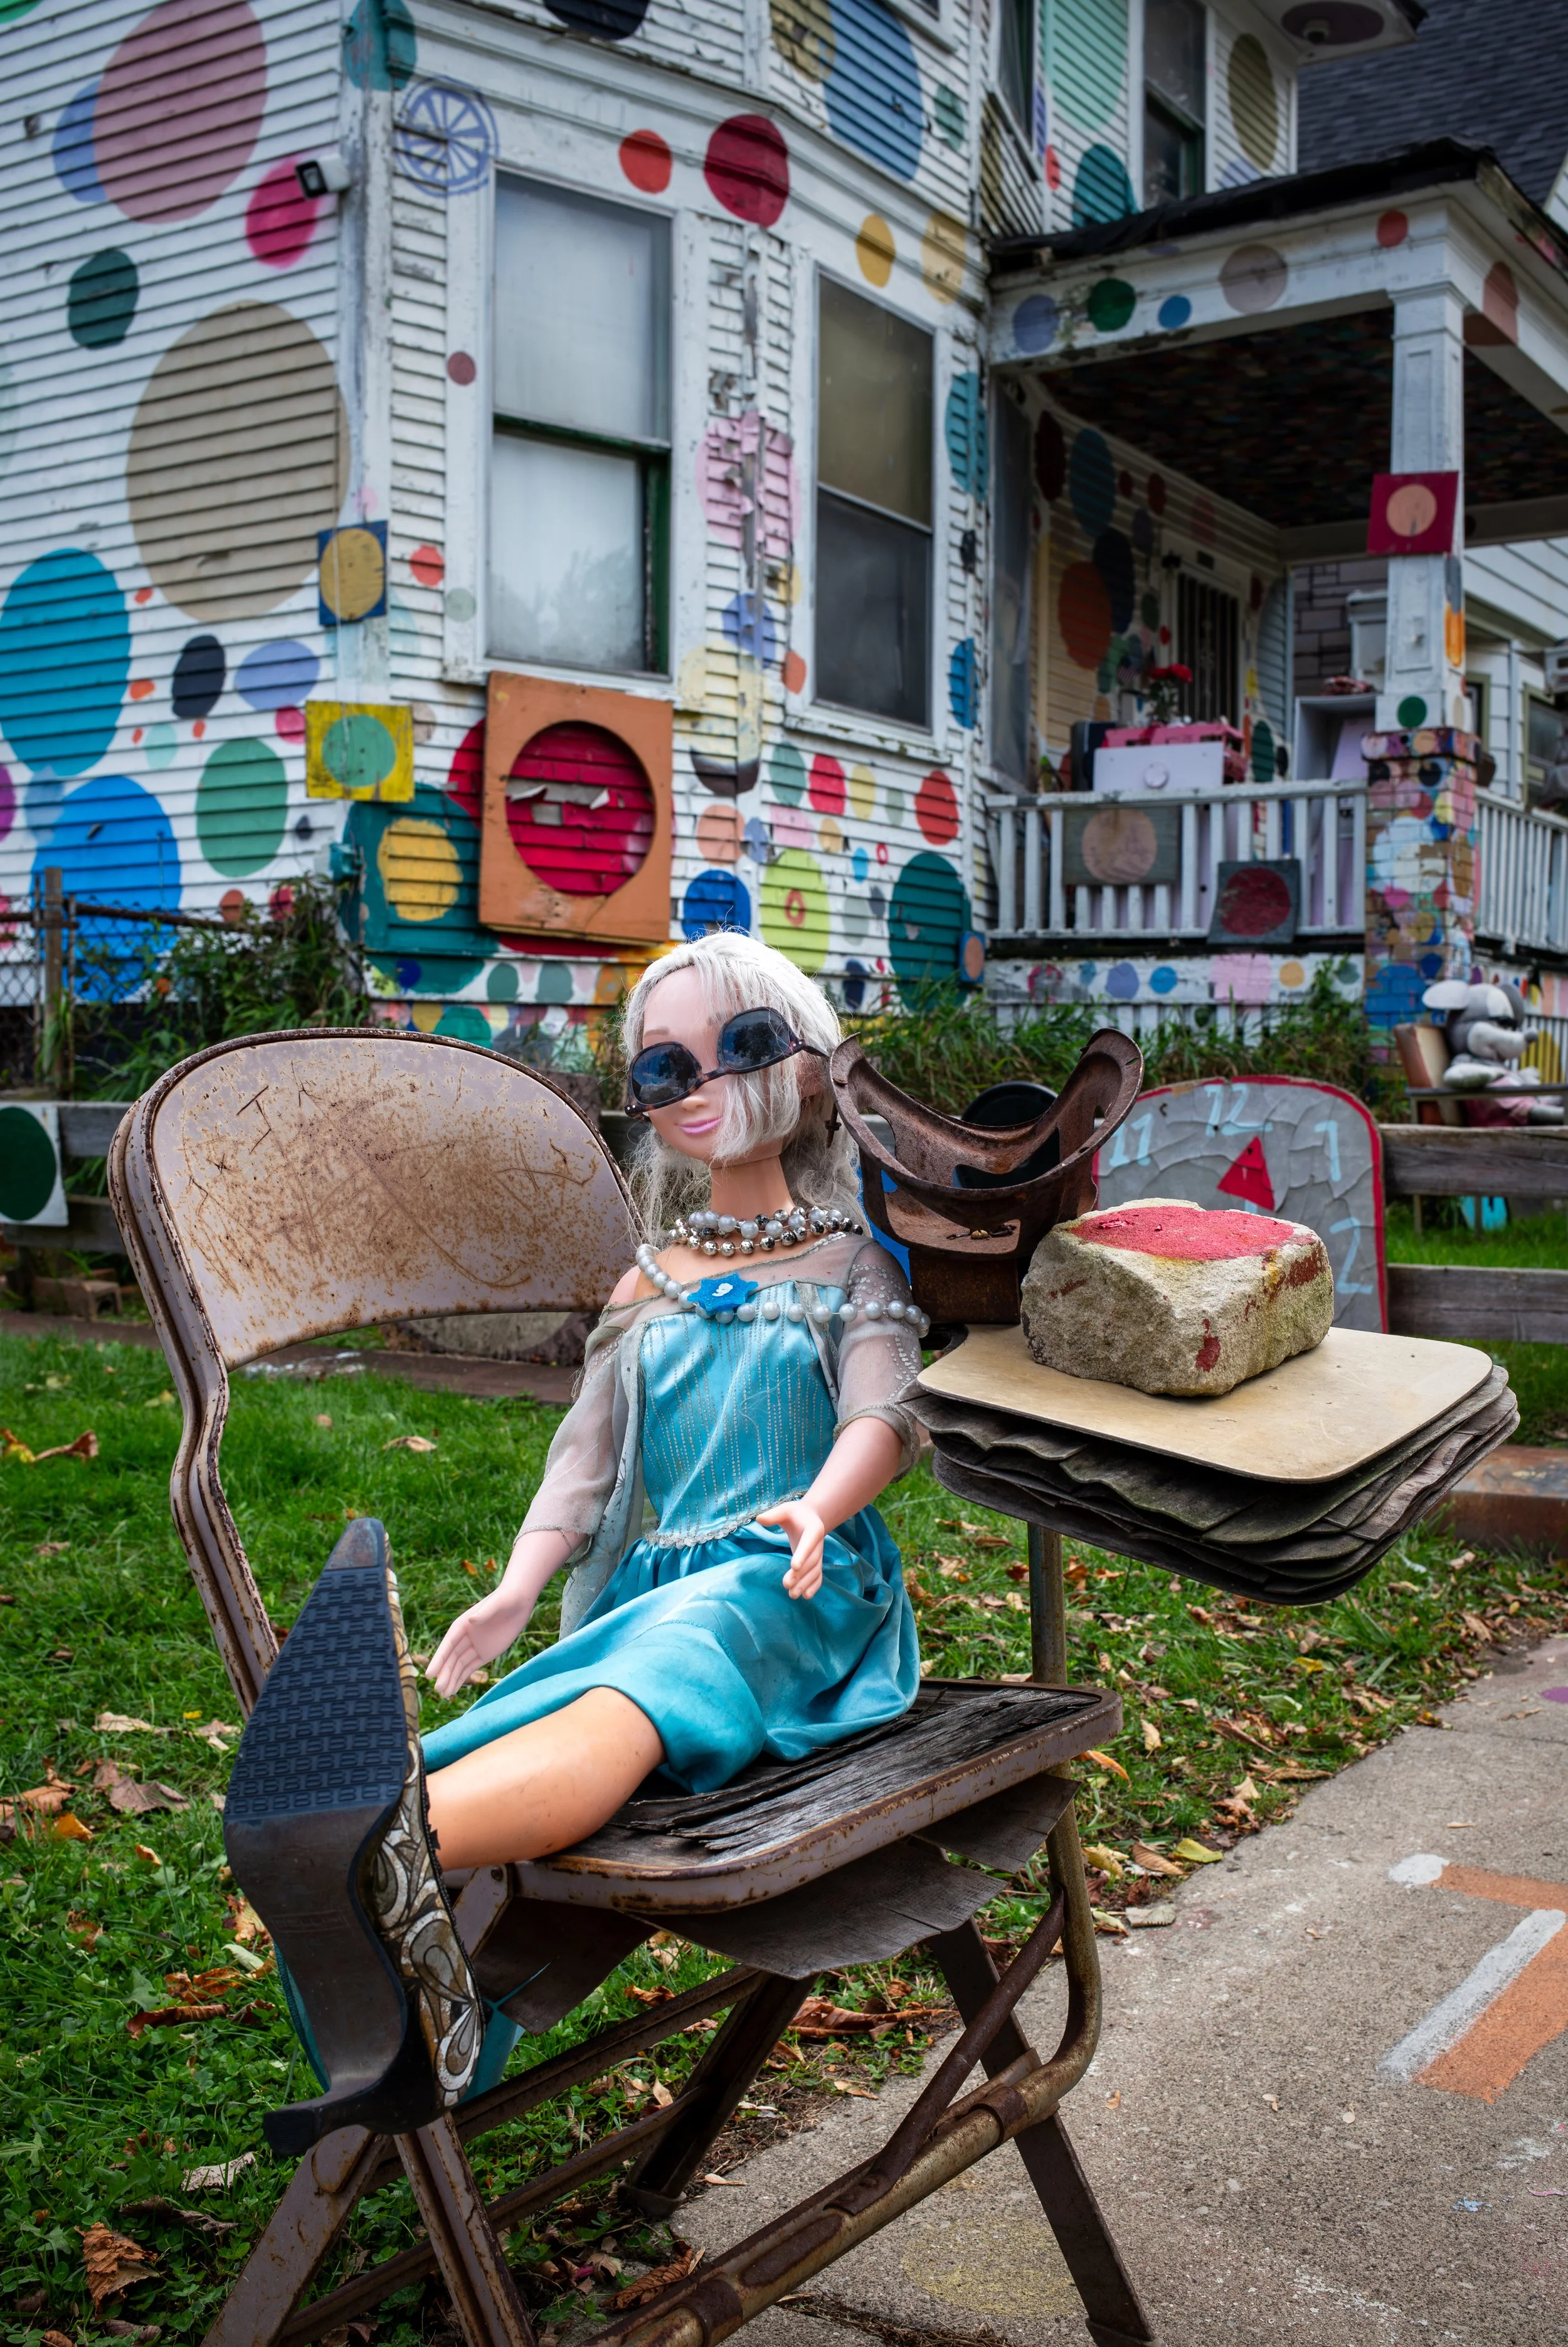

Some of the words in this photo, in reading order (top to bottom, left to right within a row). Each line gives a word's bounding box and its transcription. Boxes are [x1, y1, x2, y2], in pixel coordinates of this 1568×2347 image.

[1109, 1113, 1153, 1167] 11
[1204, 1083, 1273, 1138] 12
[1315, 1120, 1341, 1183] 1
[1329, 1217, 1373, 1295] 2
